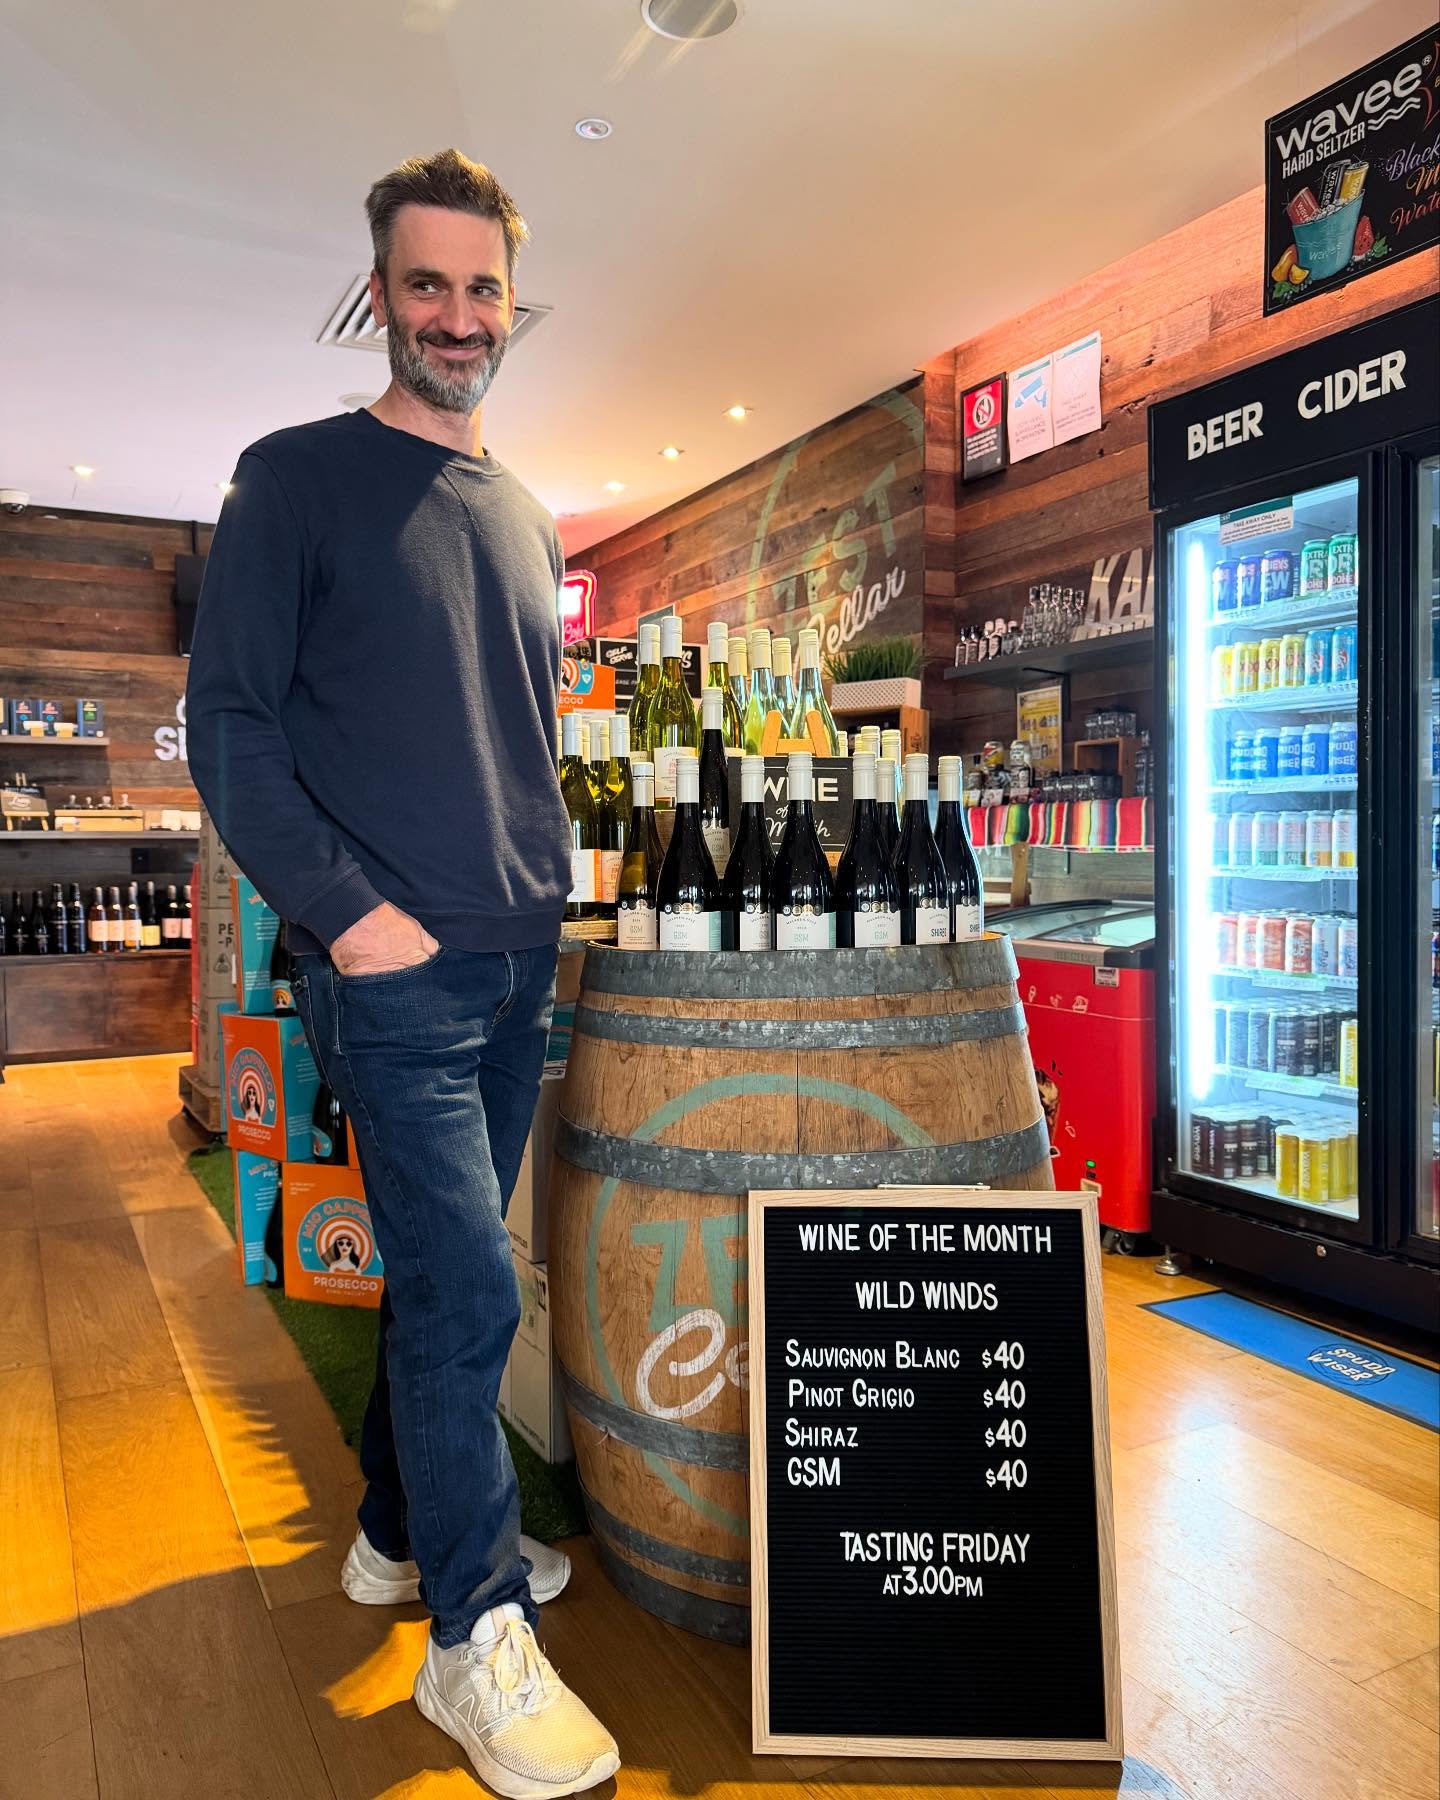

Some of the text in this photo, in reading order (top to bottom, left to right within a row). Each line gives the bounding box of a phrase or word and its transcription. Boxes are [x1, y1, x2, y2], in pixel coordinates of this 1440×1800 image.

[1282, 121, 1366, 180] HARD SELTZER
[1297, 350, 1408, 420] CIDER
[1187, 401, 1264, 461] BEER
[1261, 513, 1276, 521] ONLY
[799, 1224, 1052, 1253] WINE OF THE MONTH
[313, 1276, 378, 1292] PROSECCO
[855, 1281, 999, 1311] WILD WINDS
[981, 1341, 1026, 1370] $40
[1307, 1352, 1374, 1382] WISER
[1326, 1347, 1398, 1376] SPUDD
[983, 1379, 1027, 1410] $40
[984, 1418, 1028, 1448] $40
[787, 1457, 1029, 1490] GSM $40
[840, 1532, 1032, 1564] TASTING FRIDAY
